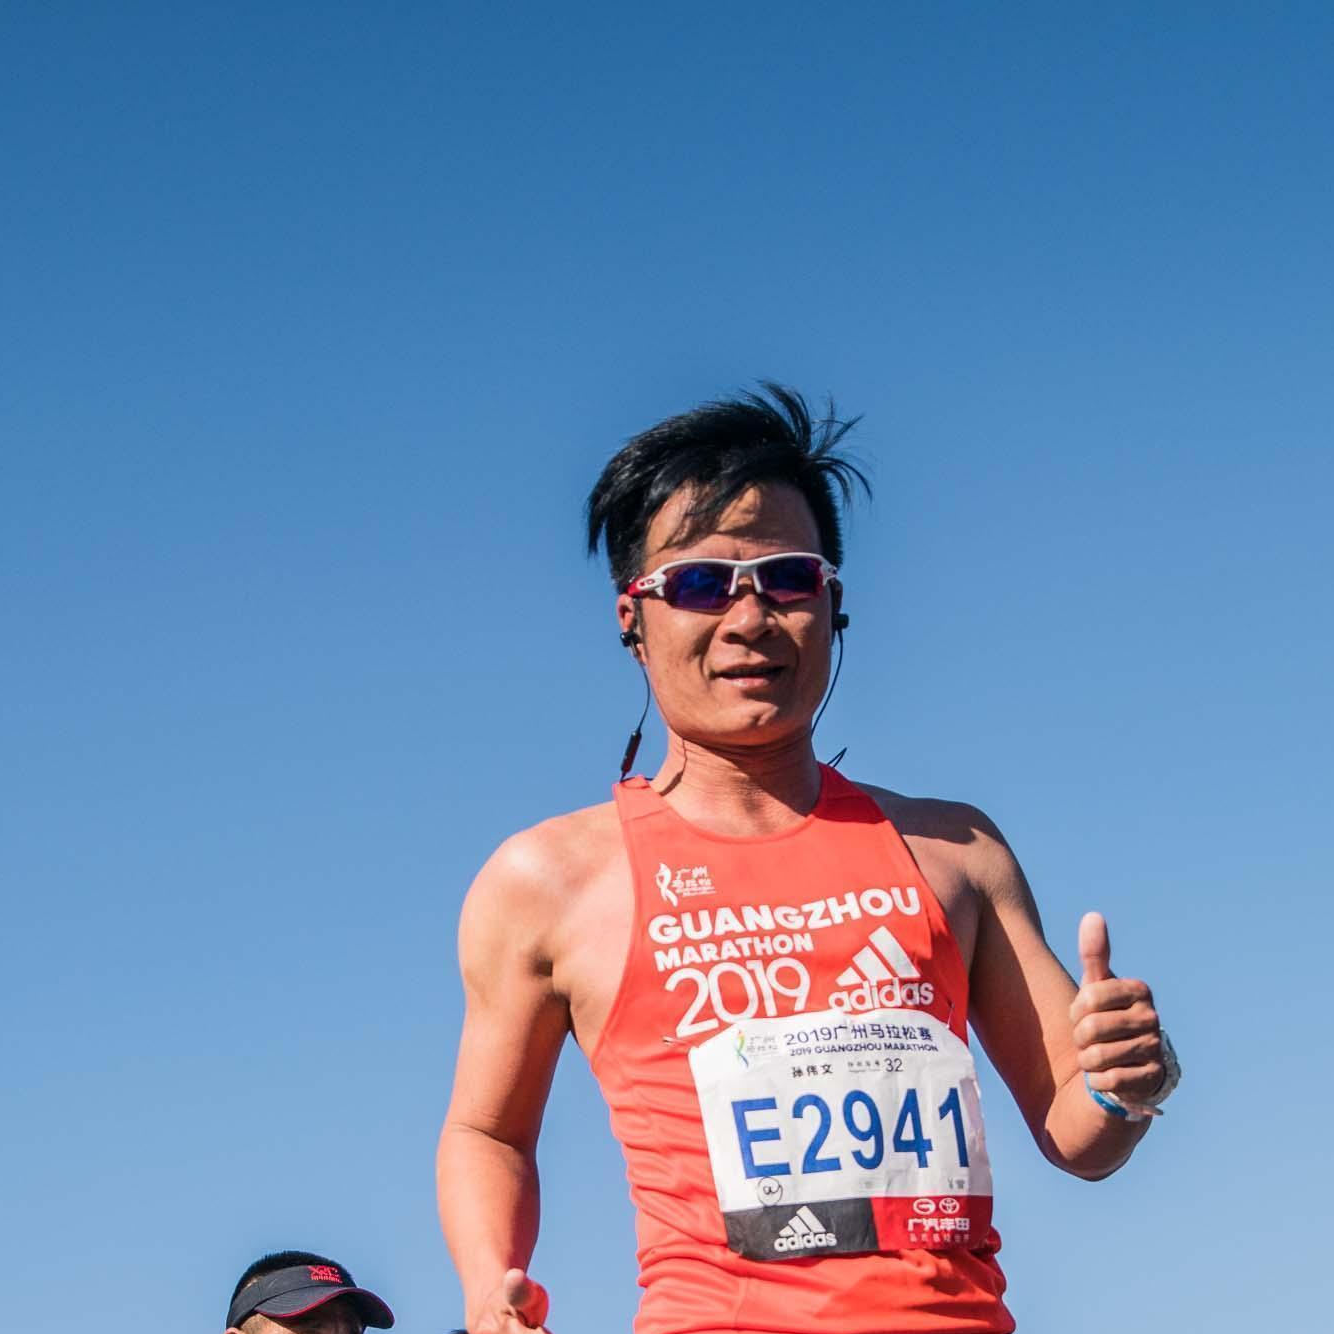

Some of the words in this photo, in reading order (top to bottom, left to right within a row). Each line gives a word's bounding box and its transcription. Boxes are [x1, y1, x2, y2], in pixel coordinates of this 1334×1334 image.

[648, 886, 921, 945] GUANGZHOU
[654, 932, 815, 972] MARATHON
[664, 957, 811, 1038] 2019
[828, 976, 934, 1013] adidas
[784, 1023, 933, 1046] 2019广州马拉松赛
[789, 1047, 813, 1057] 2019
[815, 1042, 883, 1054] GUANGZHOU
[884, 1042, 939, 1053] MARATHON
[884, 1058, 904, 1073] 32
[731, 1087, 970, 1180] E2941
[774, 1231, 838, 1253] adidas
